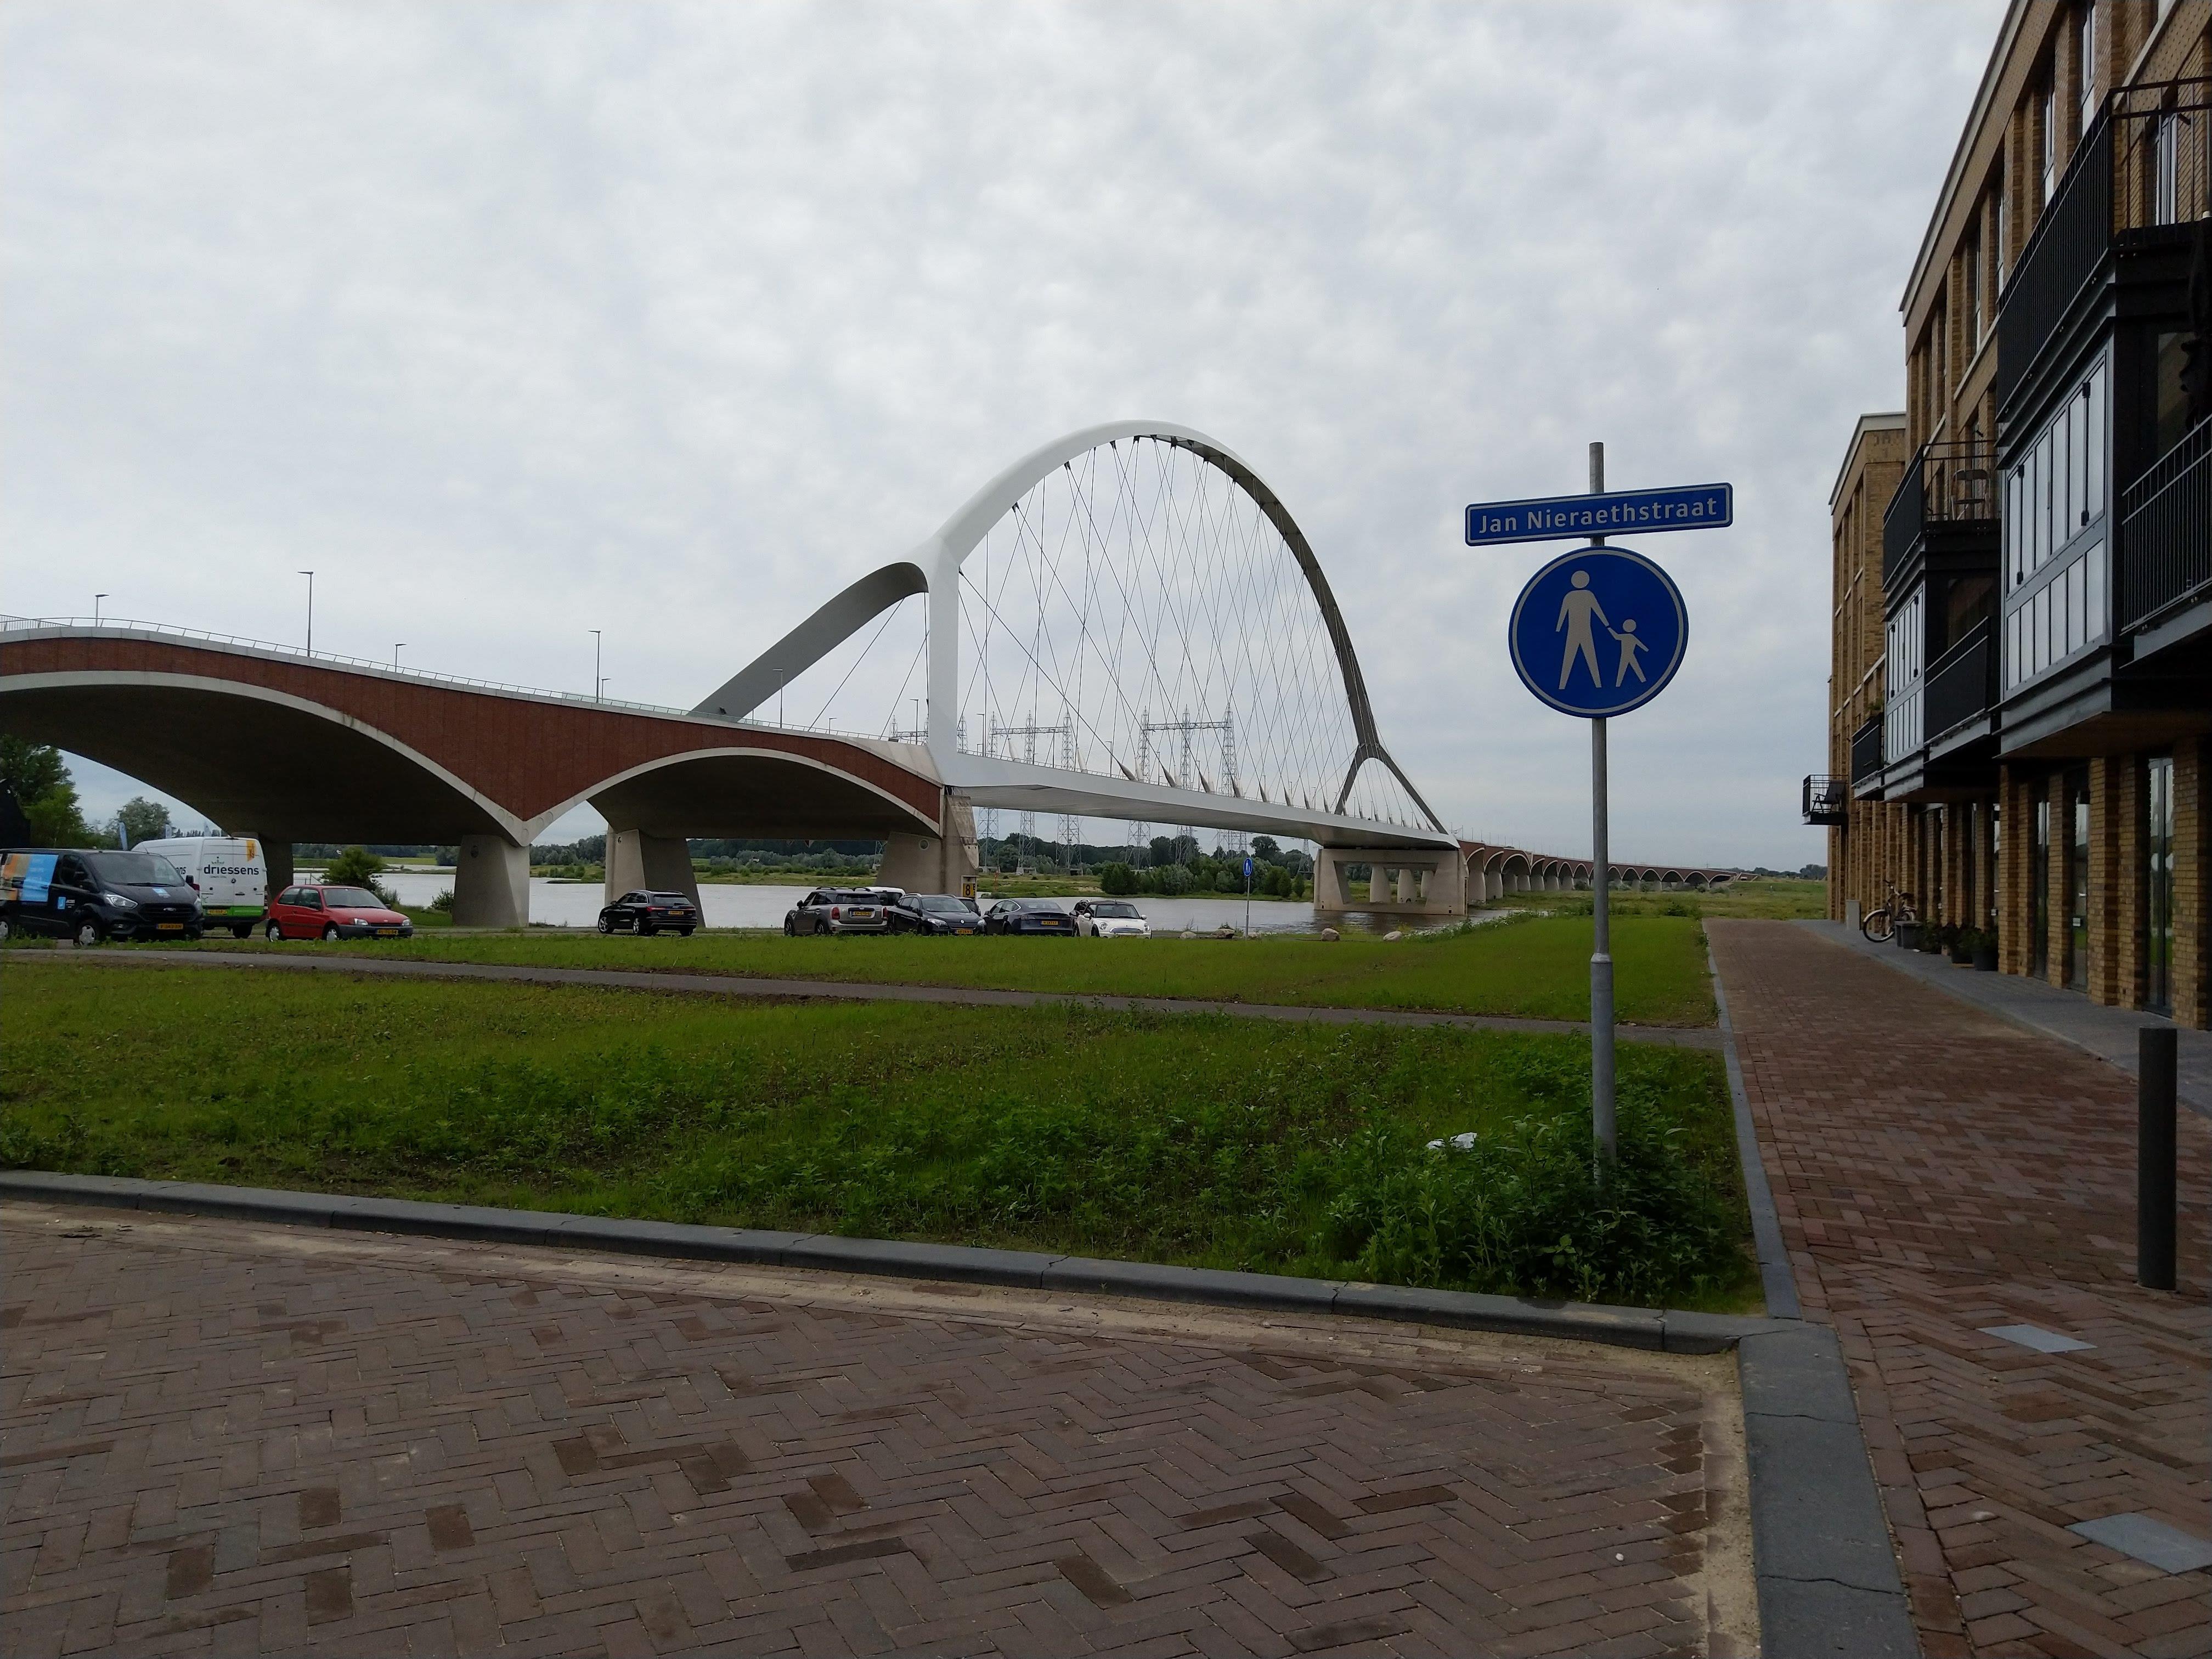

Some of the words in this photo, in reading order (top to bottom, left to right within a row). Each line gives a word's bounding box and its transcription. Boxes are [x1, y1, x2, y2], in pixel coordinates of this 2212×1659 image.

[1479, 515, 1516, 534] Jan
[1527, 497, 1717, 529] Nieraethstraat
[204, 864, 259, 875] driessens
[966, 884, 970, 896] 8
